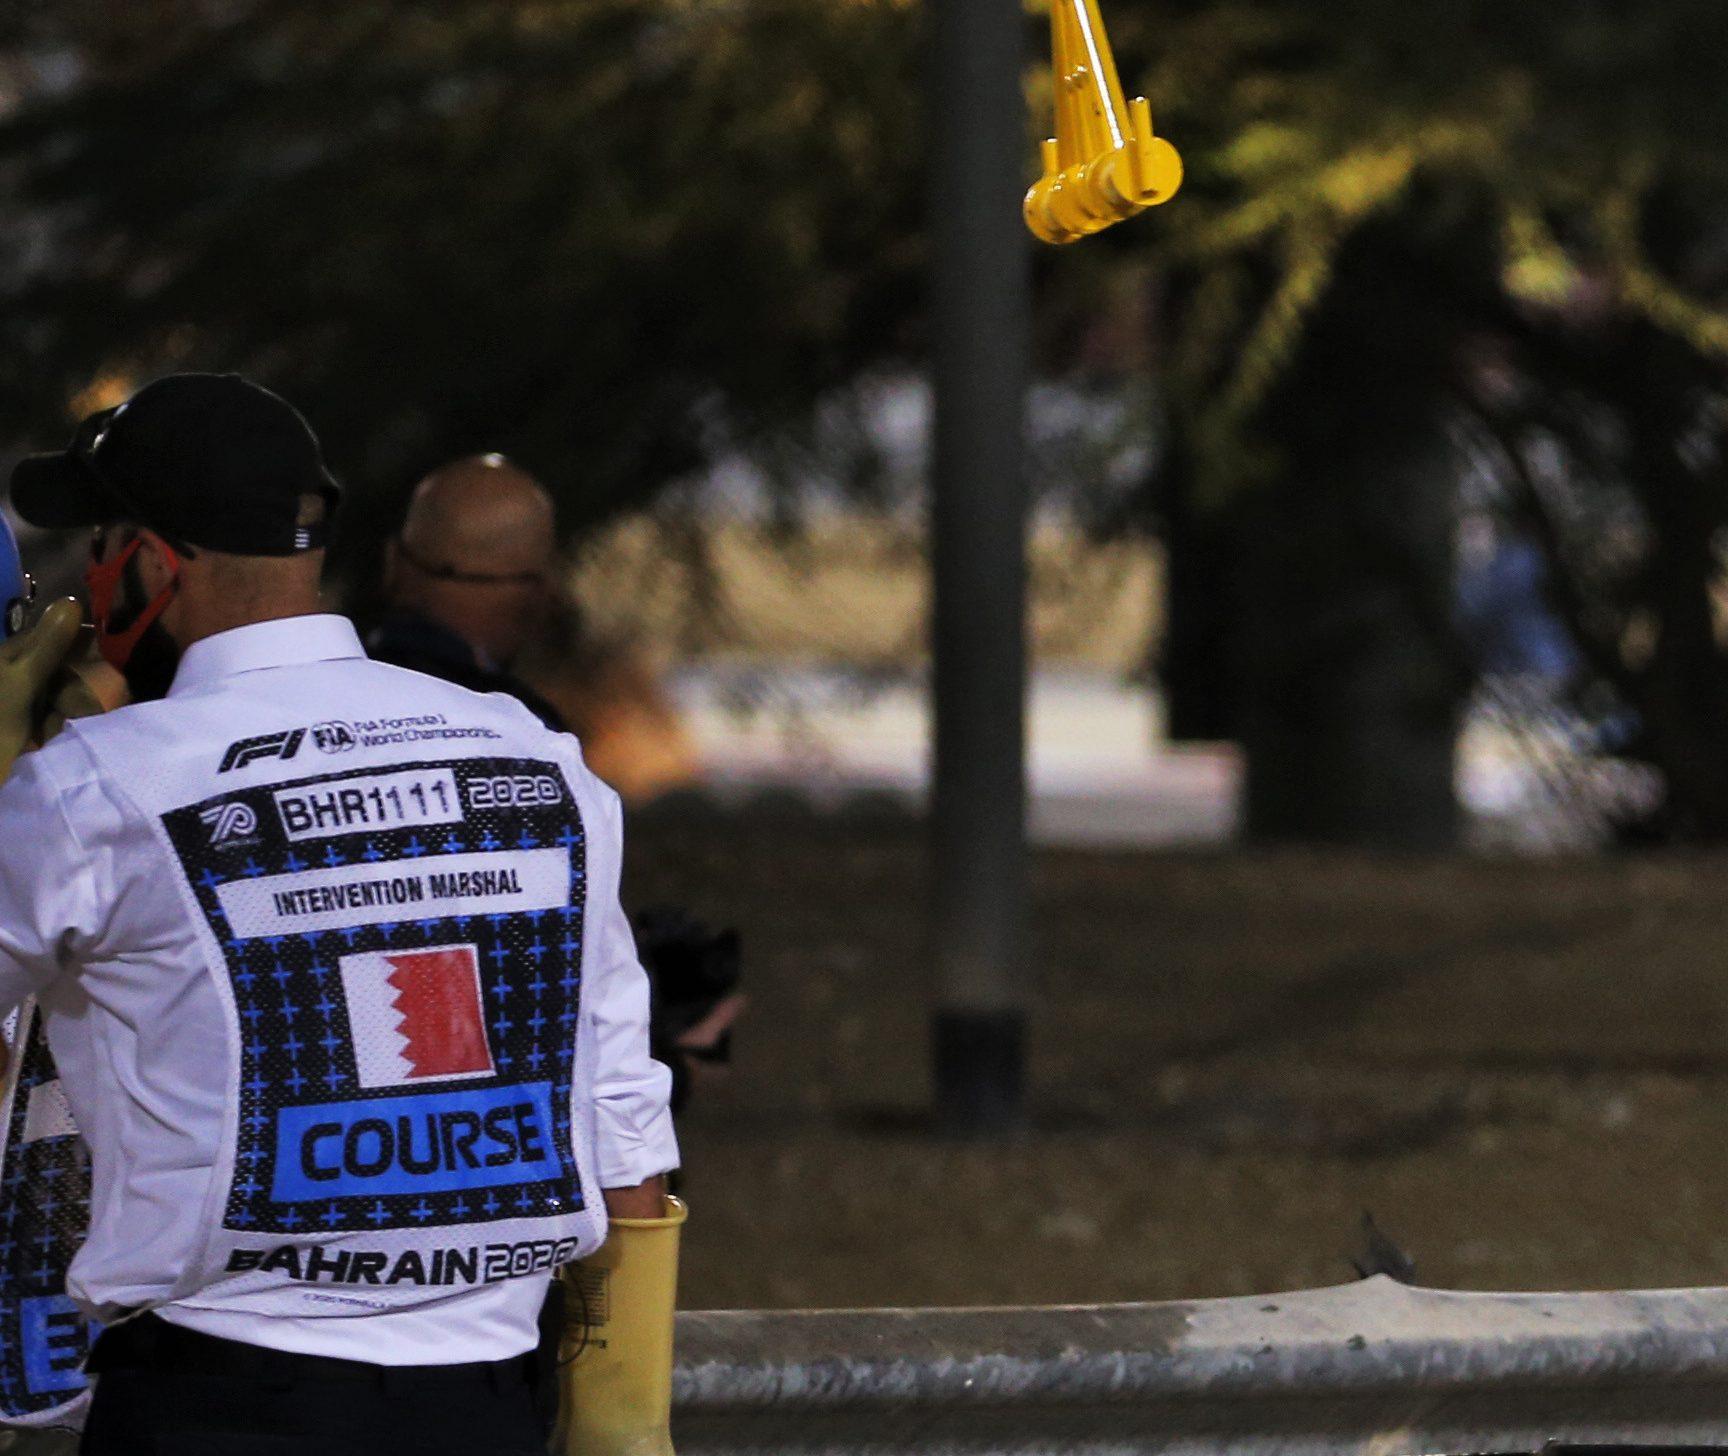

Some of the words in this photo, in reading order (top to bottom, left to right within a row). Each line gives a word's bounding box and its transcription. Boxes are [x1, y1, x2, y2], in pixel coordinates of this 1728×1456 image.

[281, 780, 449, 833] BHR1111
[467, 776, 562, 809] 2020
[273, 875, 424, 917] INTERVENTION
[429, 868, 524, 899] MARSHAL
[301, 1102, 546, 1182] COURSE
[224, 1244, 478, 1286] BAHRAIN
